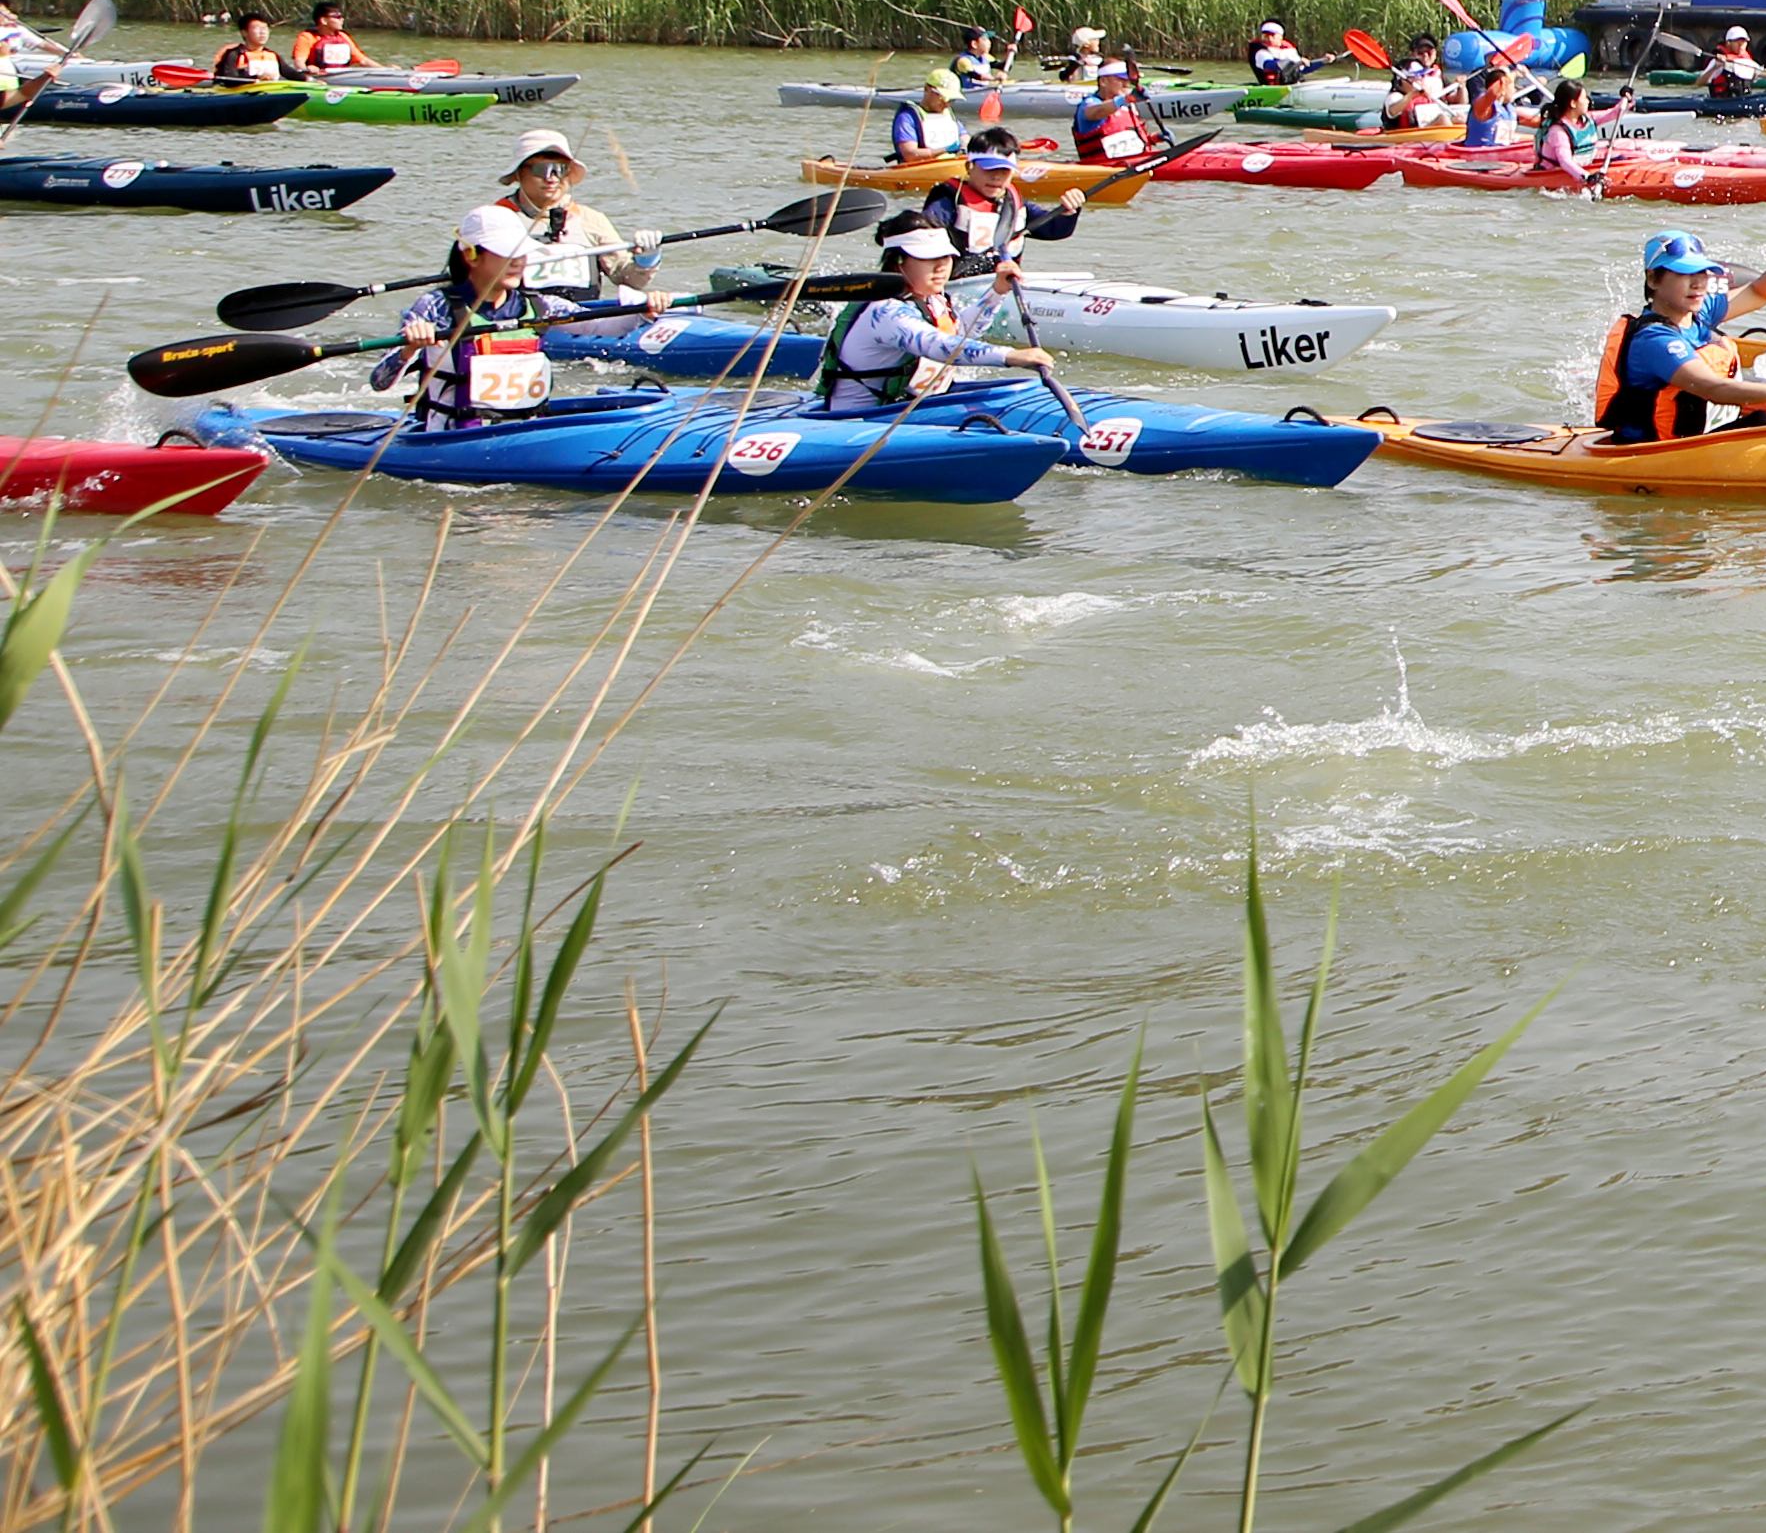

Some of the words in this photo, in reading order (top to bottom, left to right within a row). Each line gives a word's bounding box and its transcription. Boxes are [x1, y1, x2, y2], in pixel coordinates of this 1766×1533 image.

[495, 85, 545, 104] Liker
[410, 104, 461, 123] Liker
[1159, 101, 1211, 118] Liker
[1233, 98, 1263, 112] iker
[1601, 125, 1653, 141] Lker
[106, 169, 136, 180] 279
[250, 183, 336, 212] Liker
[1706, 276, 1728, 294] 65
[1083, 297, 1116, 315] 269
[645, 326, 677, 345] 243
[1239, 326, 1331, 370] Liker
[478, 371, 546, 402] 256
[734, 440, 786, 461] 256
[1083, 429, 1132, 453] 257
